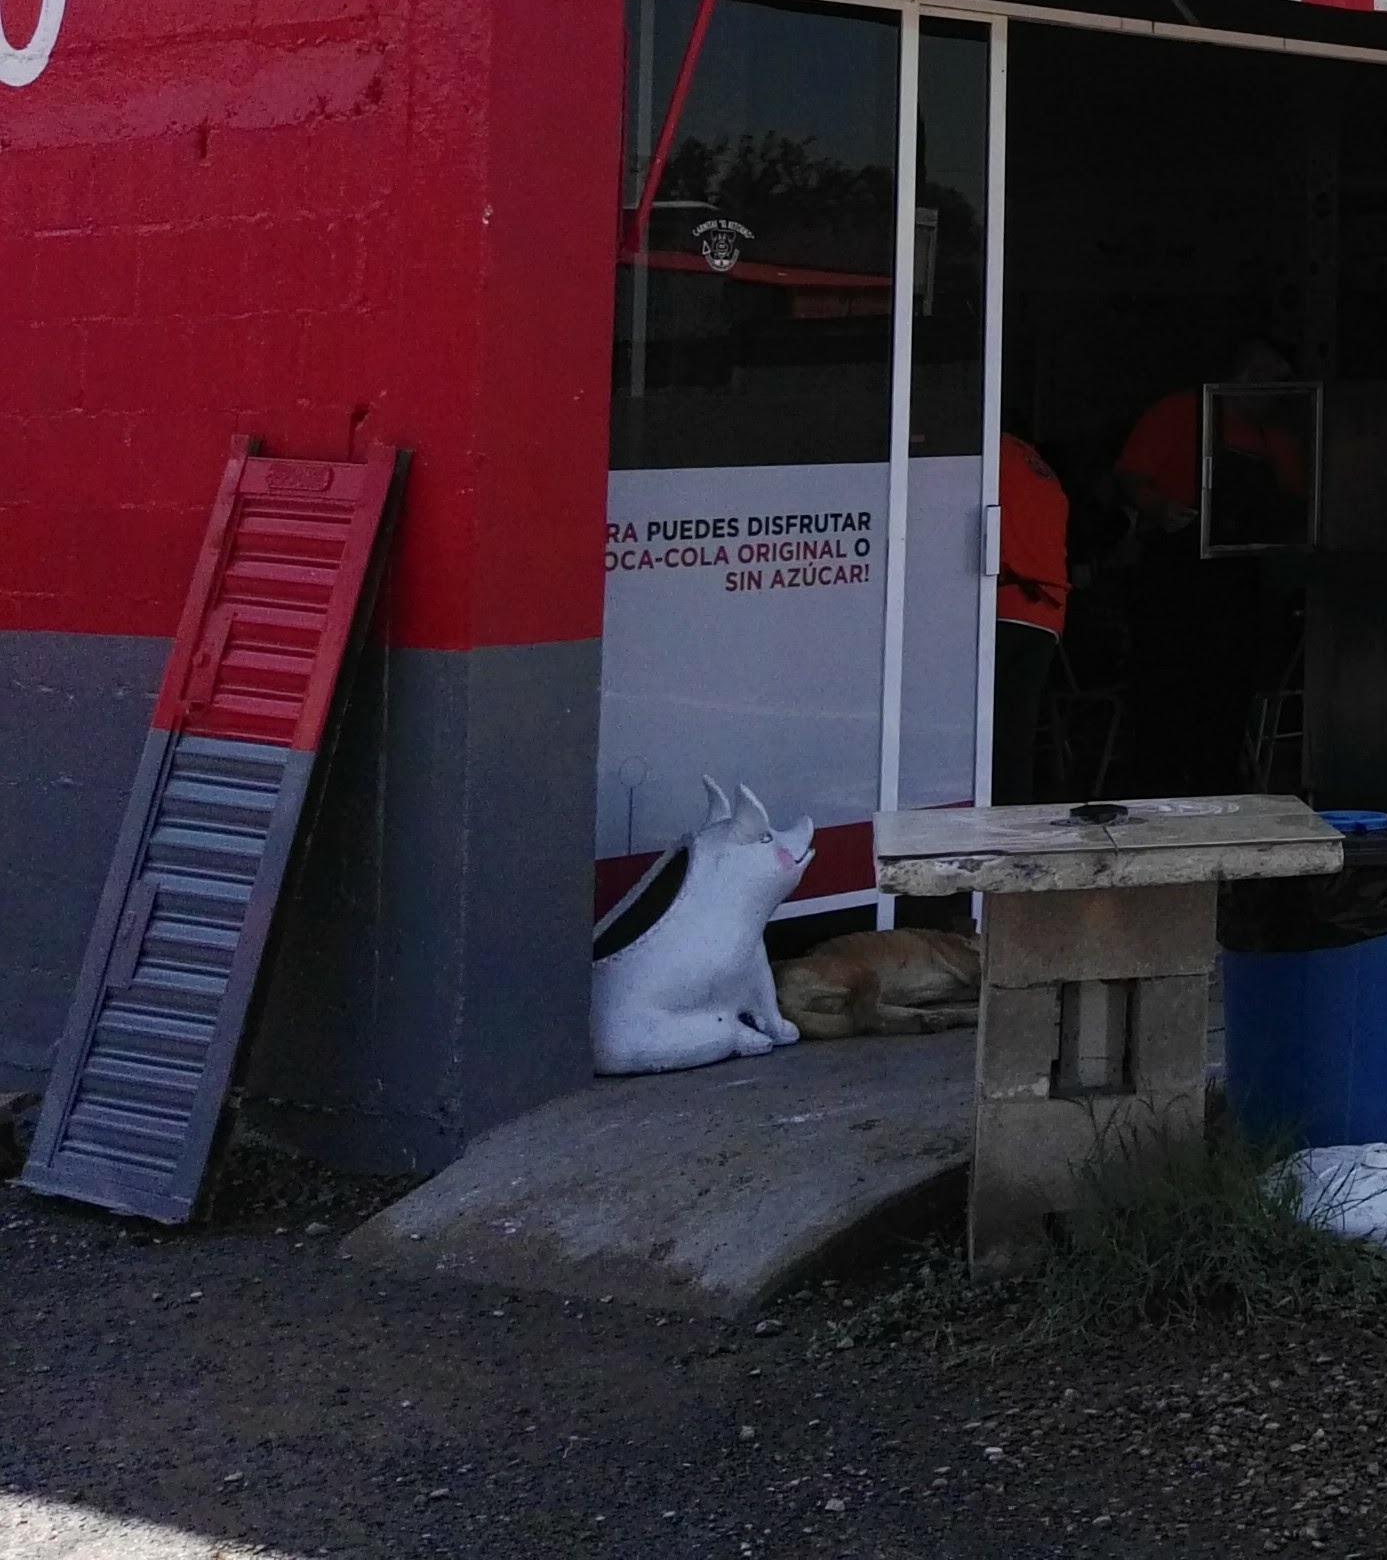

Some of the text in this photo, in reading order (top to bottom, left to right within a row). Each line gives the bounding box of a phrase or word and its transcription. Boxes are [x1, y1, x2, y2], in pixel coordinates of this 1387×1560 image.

[647, 517, 740, 542] PUEDES
[747, 511, 872, 536] DISFRUTAR
[737, 539, 847, 565] ORIGINAL
[853, 537, 871, 558] O
[725, 562, 871, 592] SIN AZÚCAR!
